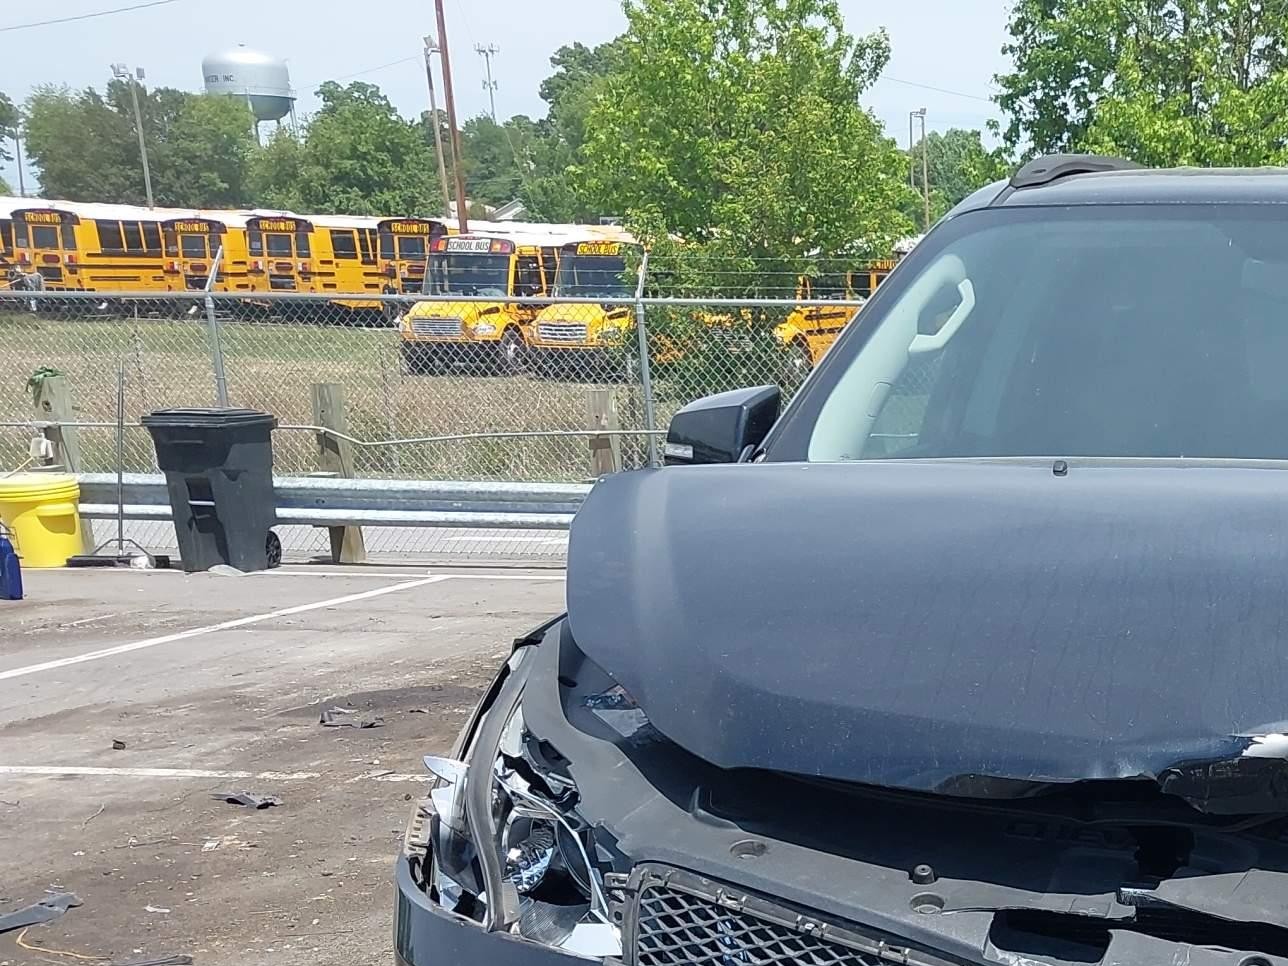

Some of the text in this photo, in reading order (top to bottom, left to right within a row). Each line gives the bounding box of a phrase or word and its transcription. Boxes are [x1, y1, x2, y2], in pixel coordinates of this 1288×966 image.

[25, 212, 61, 223] SCHOOL BUS
[175, 222, 209, 232] SCHOOL BUS
[260, 220, 296, 231] SCHOOL BUS
[392, 223, 429, 233] SCHOOL BUS
[449, 241, 489, 250] SCHOOL BUS
[579, 244, 617, 255] SCHOOL BUS
